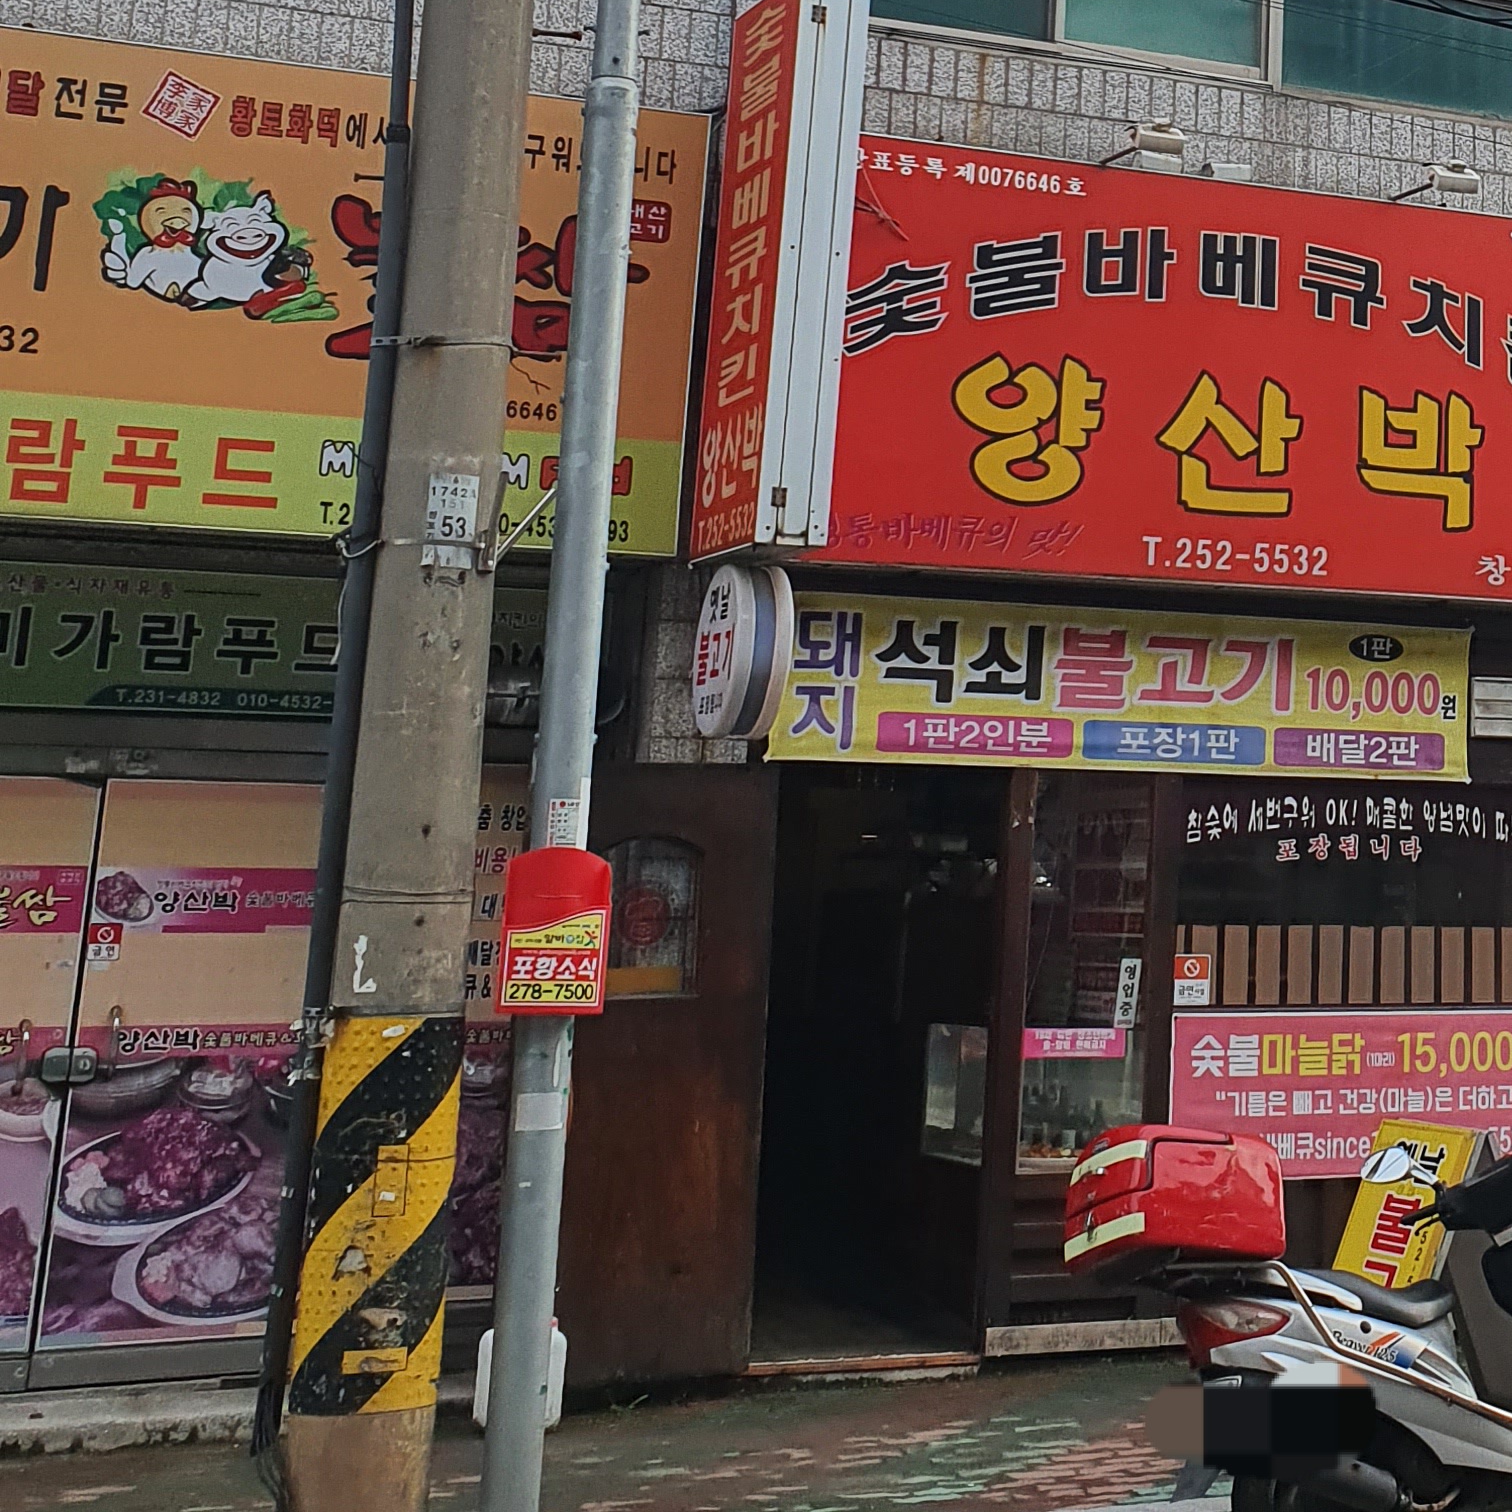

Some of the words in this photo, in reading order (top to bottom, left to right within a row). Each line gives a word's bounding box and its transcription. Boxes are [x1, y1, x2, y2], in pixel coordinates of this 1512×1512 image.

[0, 69, 46, 118] 달
[54, 76, 130, 125] 전문
[717, 2, 787, 408] 숯불바베큐치킨
[6, 417, 278, 510] 람푸드
[701, 400, 763, 509] 양산박
[951, 350, 1486, 534] 양산박
[440, 515, 468, 539] 53
[697, 501, 756, 554] T.252-5532
[1141, 534, 1330, 578] T.252-5532
[696, 622, 736, 687] 불고기
[1359, 637, 1394, 660] 1판
[115, 687, 222, 707] T.231-4832
[236, 691, 334, 711] 010-4532-
[790, 609, 865, 753] 돼지
[1305, 666, 1458, 722] 10,000원
[903, 717, 1054, 755] 1판2인분
[1116, 725, 1240, 761] 포장1판
[1305, 732, 1420, 768] 배달2판
[1325, 798, 1359, 827] OK!
[1365, 796, 1414, 832] 매콤한
[153, 889, 241, 914] 양산박
[508, 982, 595, 1001] 278-7500
[511, 955, 598, 980] 포항소식
[1118, 963, 1137, 1017] 영업중
[116, 1027, 202, 1055] 양산박
[1190, 1031, 1366, 1079] 숯불마늘닭
[1366, 1050, 1396, 1068] (1마리)
[1292, 1088, 1334, 1116] 빼고
[1338, 1084, 1454, 1117] 건강(마늘)은
